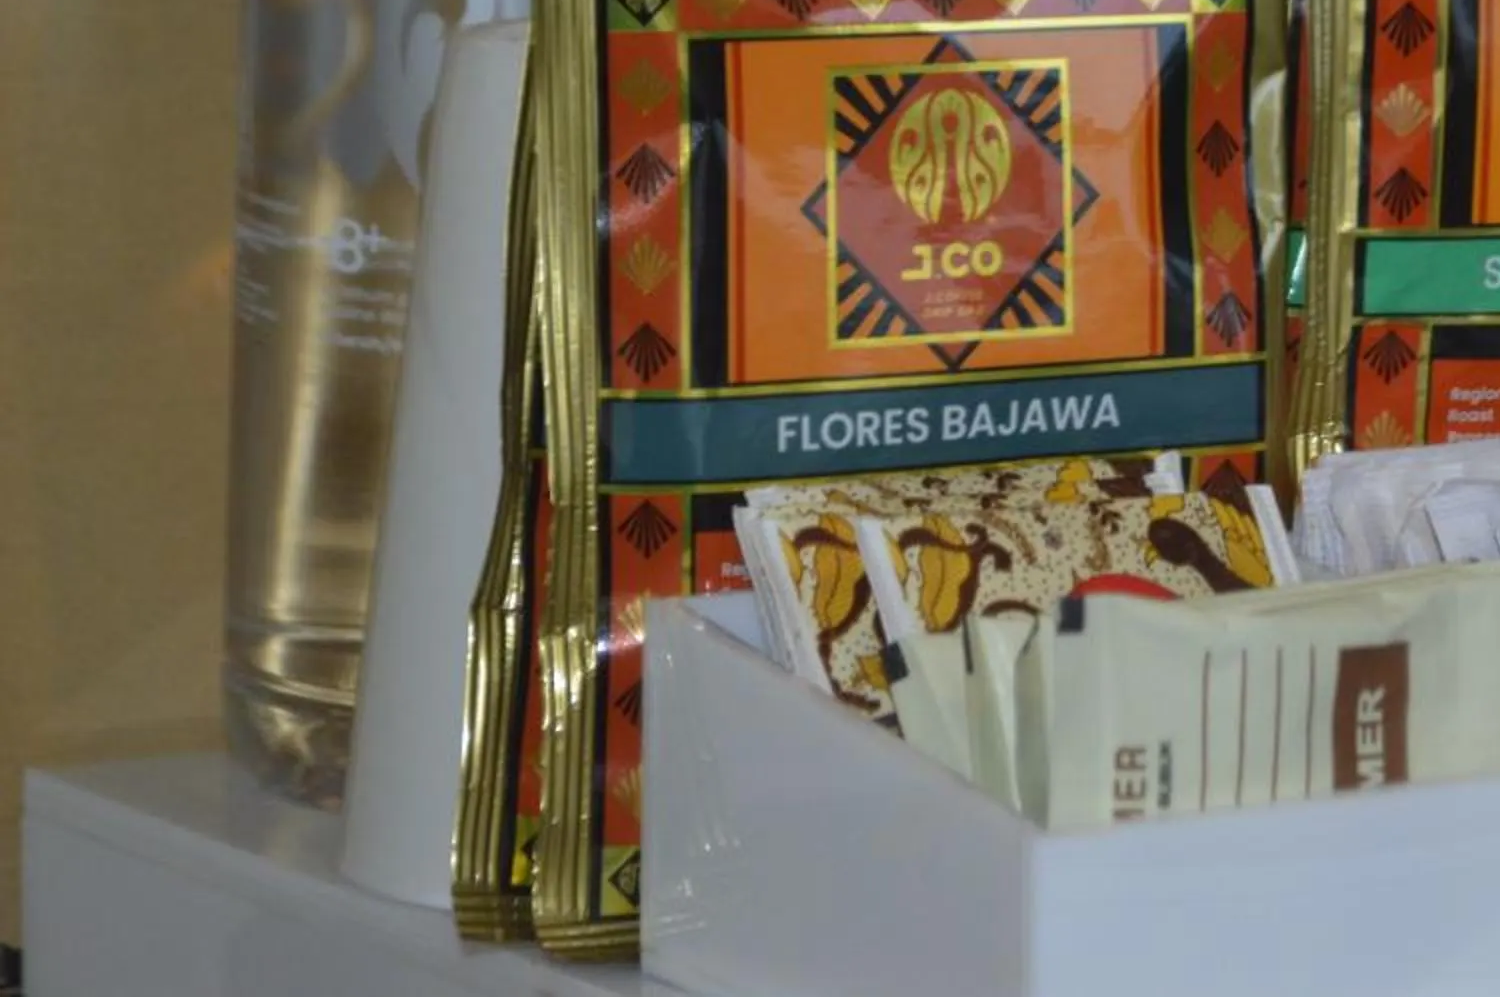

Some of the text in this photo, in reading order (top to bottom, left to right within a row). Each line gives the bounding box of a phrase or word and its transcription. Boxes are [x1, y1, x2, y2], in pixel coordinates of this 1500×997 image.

[901, 241, 1003, 280] J.CO
[777, 392, 1121, 453] FLORES BAJAWA
[1447, 408, 1495, 423] Roast
